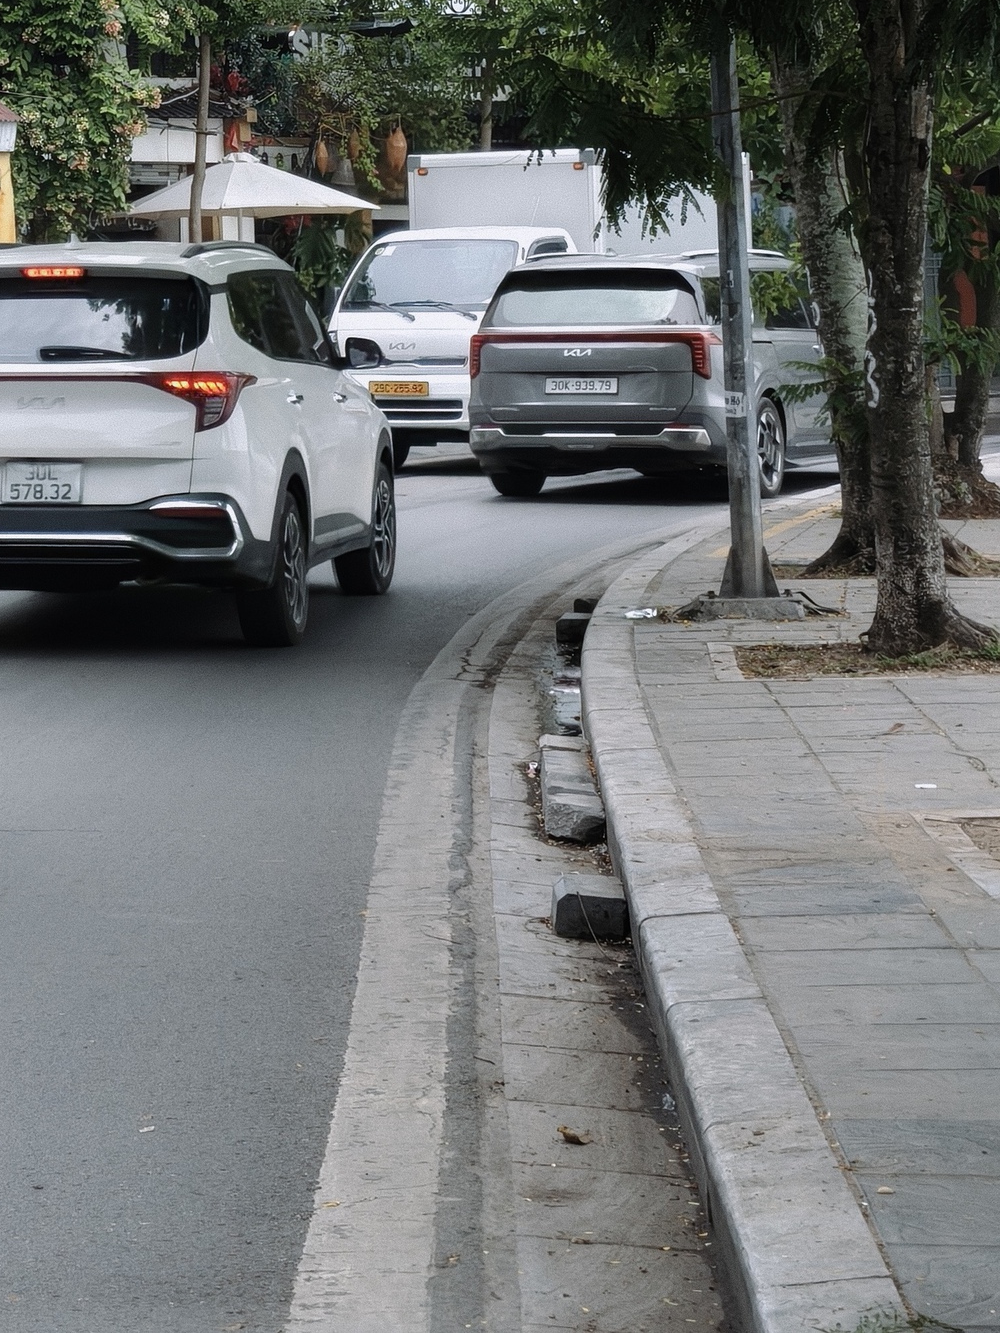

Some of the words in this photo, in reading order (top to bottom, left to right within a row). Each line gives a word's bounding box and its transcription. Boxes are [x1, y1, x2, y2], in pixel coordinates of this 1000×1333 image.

[563, 348, 592, 357] KIA
[551, 380, 612, 391] 30K-939.79
[9, 483, 72, 500] 578.32
